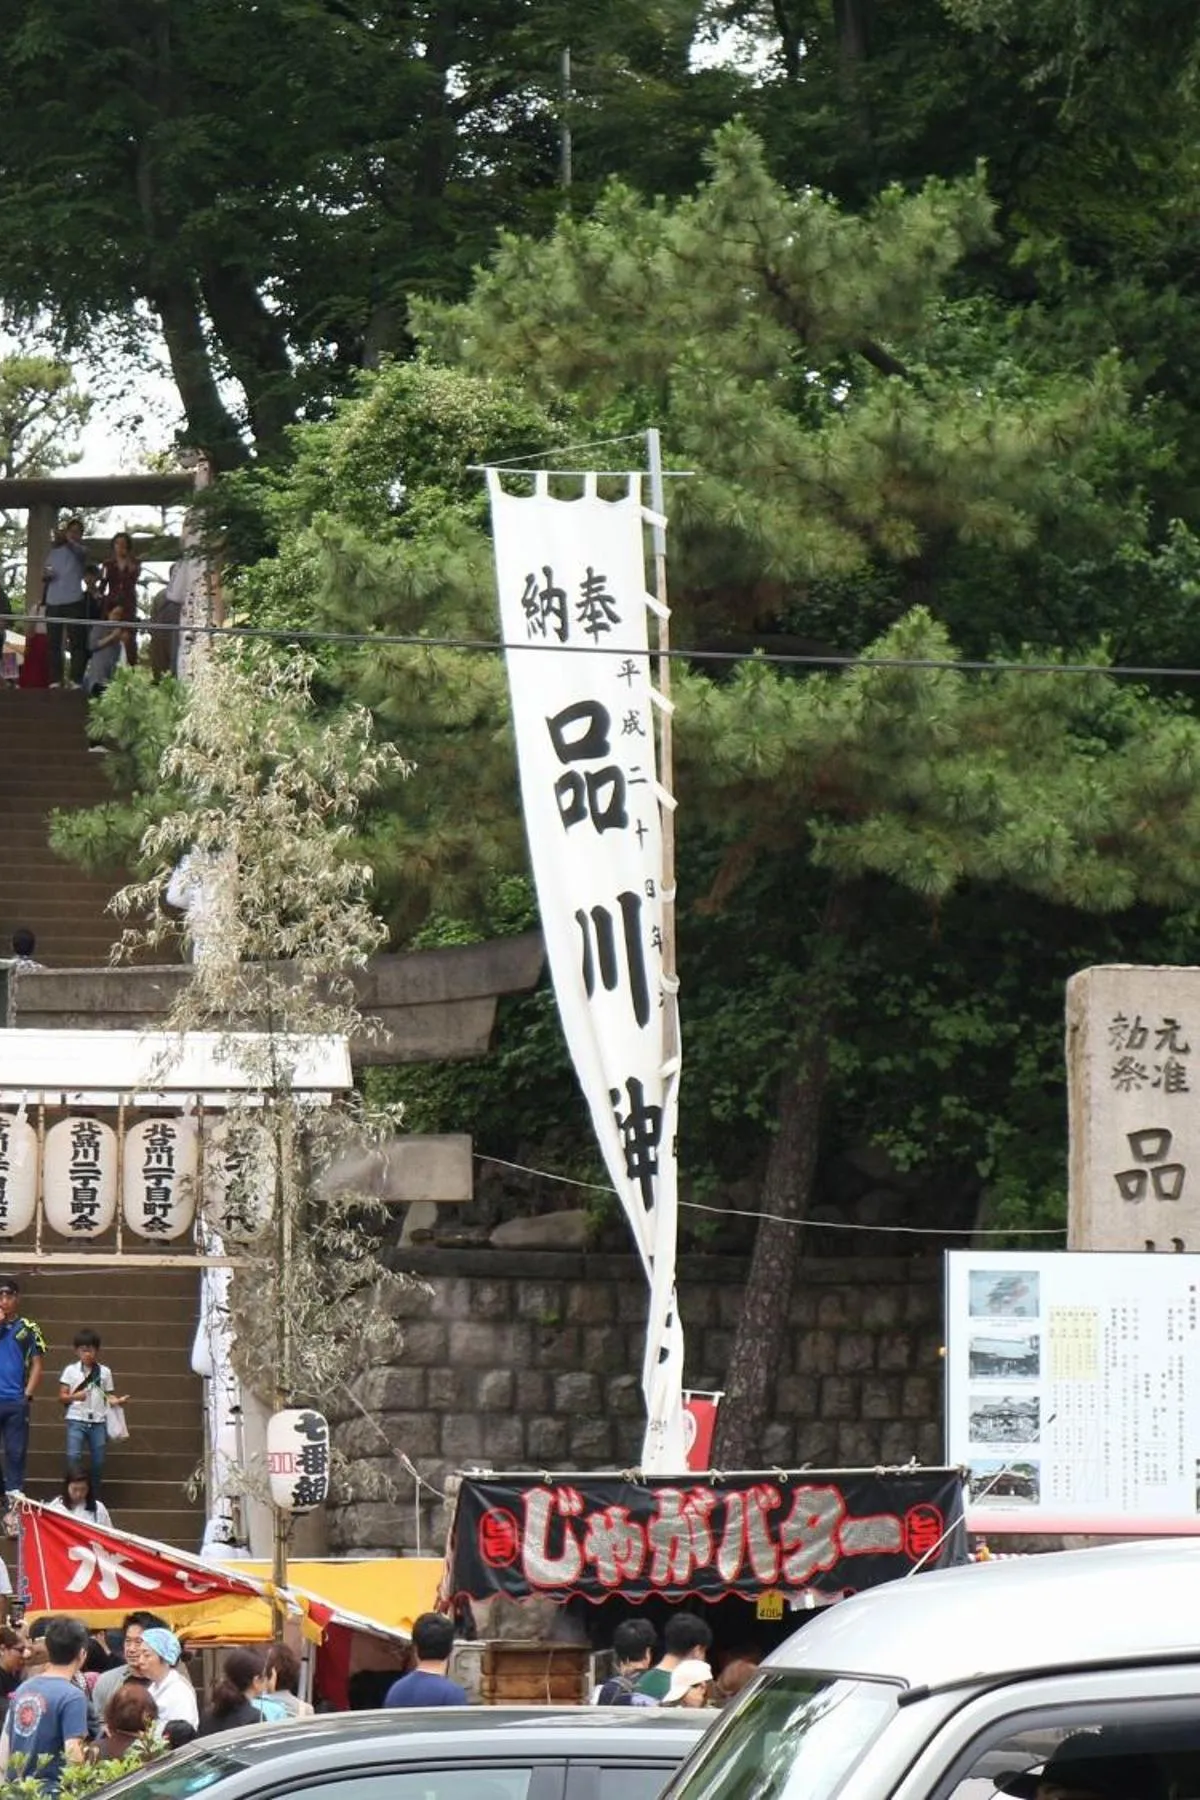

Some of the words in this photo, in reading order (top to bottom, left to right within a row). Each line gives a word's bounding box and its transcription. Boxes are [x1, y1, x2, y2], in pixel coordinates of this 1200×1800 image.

[521, 566, 621, 644] 奉納
[67, 1121, 102, 1231] 北品川二丁目町会
[141, 1123, 177, 1233] 北品川一丁目町会
[522, 1484, 902, 1588] じゃがバター
